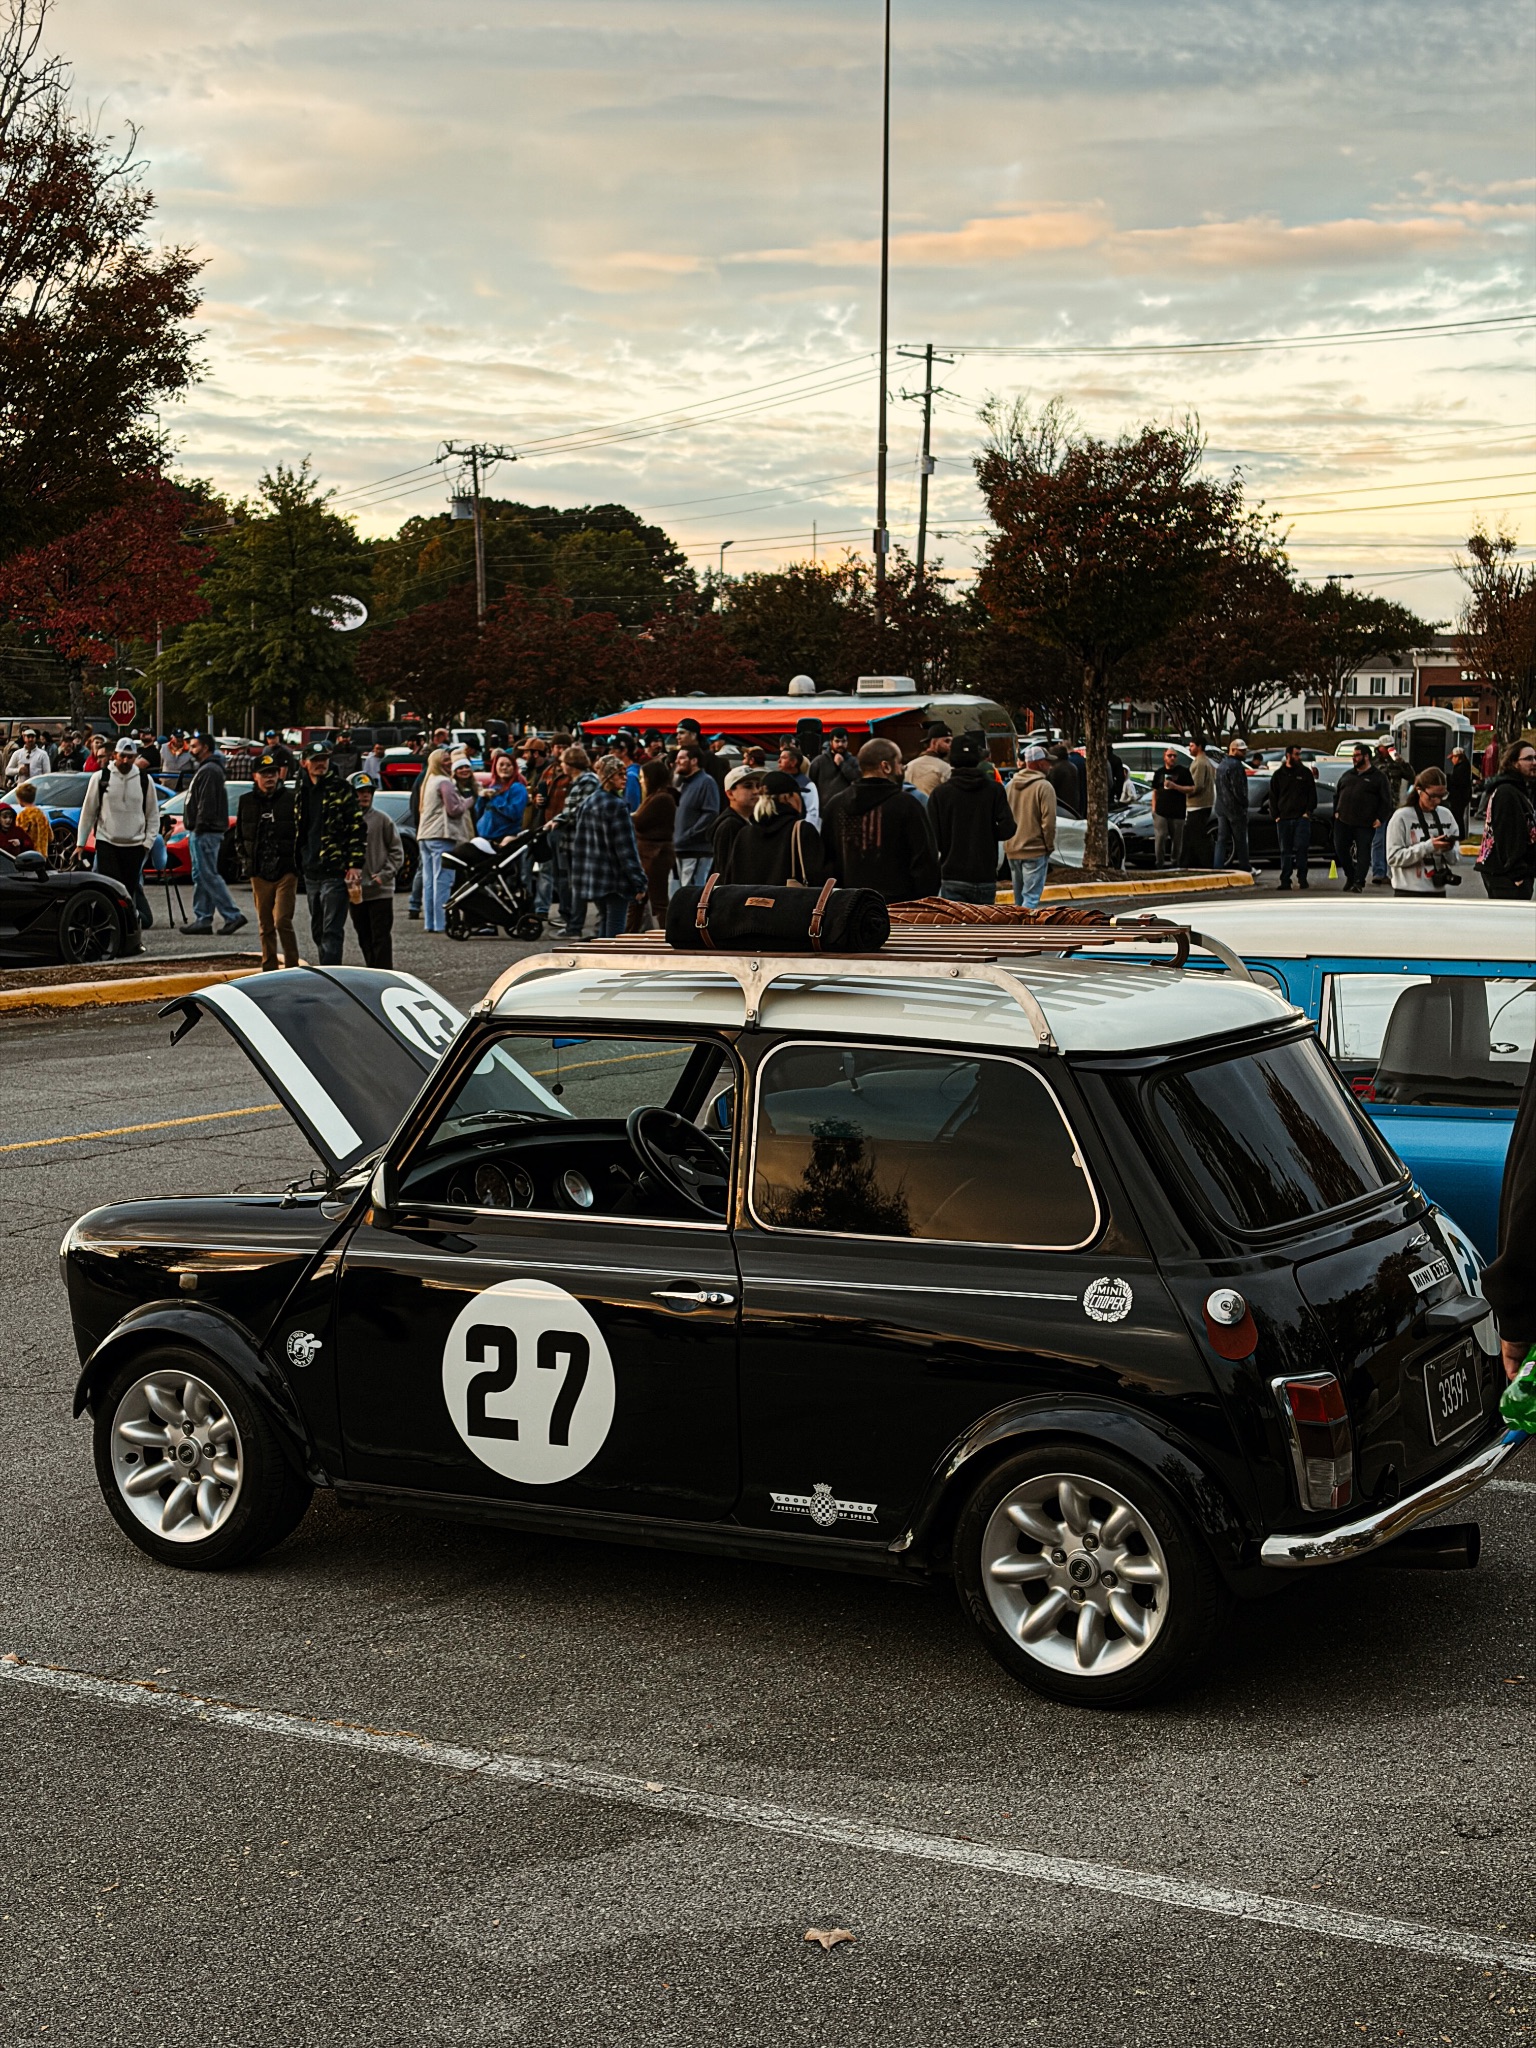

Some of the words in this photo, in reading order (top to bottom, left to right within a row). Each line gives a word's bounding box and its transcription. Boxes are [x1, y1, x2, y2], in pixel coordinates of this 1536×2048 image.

[111, 700, 134, 715] STOP
[1413, 1269, 1433, 1289] MINI
[1432, 1260, 1449, 1279] 1275
[1096, 1285, 1123, 1296] MINI
[1089, 1295, 1126, 1310] COOPER
[465, 1323, 591, 1447] 27
[776, 1505, 810, 1513] FESTIVAL
[850, 1513, 872, 1521] SPEED
